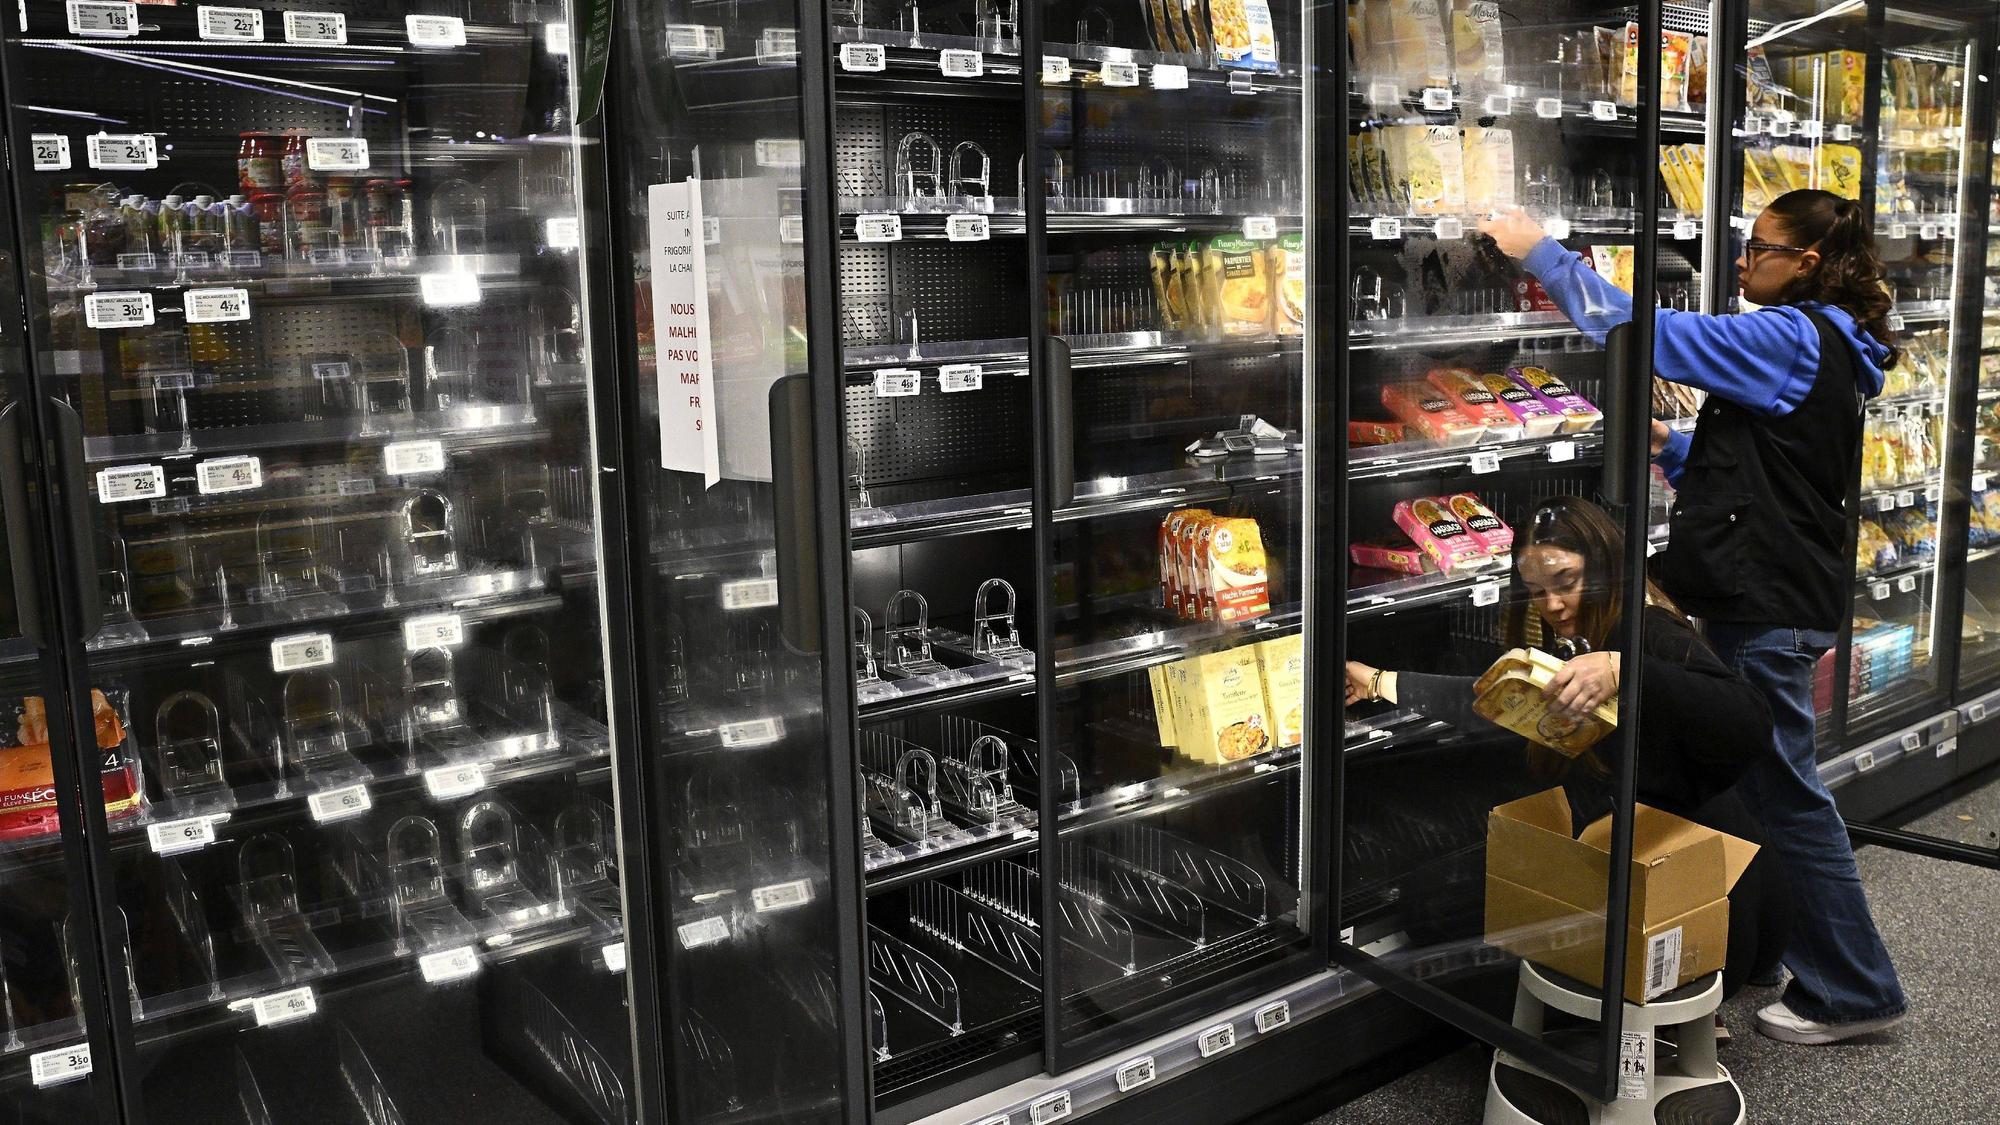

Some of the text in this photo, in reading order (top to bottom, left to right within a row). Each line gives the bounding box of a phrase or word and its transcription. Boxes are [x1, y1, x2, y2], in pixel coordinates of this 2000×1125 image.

[666, 210, 685, 220] SUITE
[669, 263, 677, 272] LA
[670, 303, 695, 315] NOUS
[668, 349, 683, 361] PAS
[104, 754, 120, 767] 4
